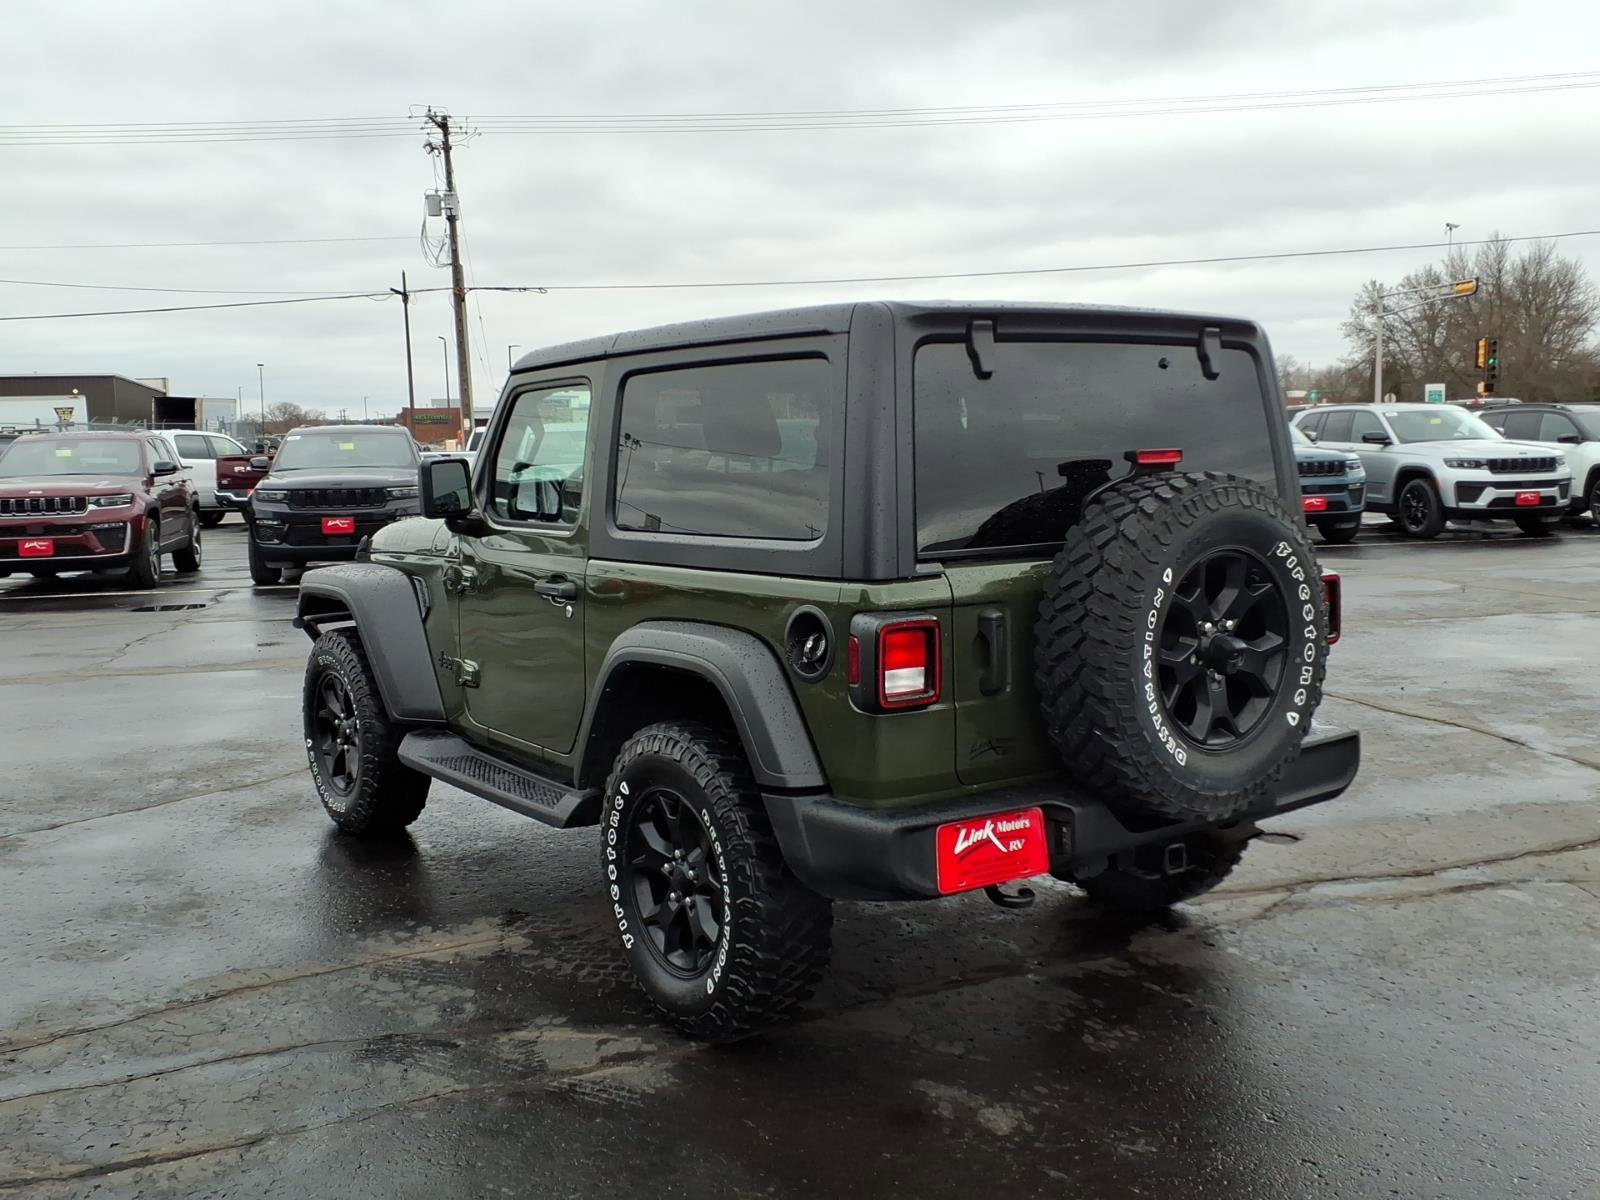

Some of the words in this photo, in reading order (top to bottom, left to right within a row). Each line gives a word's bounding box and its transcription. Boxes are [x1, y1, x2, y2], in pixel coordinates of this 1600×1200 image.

[1143, 587, 1188, 767] DESTINATION
[953, 819, 1009, 855] Link
[996, 818, 1031, 834] Motors
[1009, 838, 1026, 852] RV
[701, 808, 731, 983] DESTINATION
